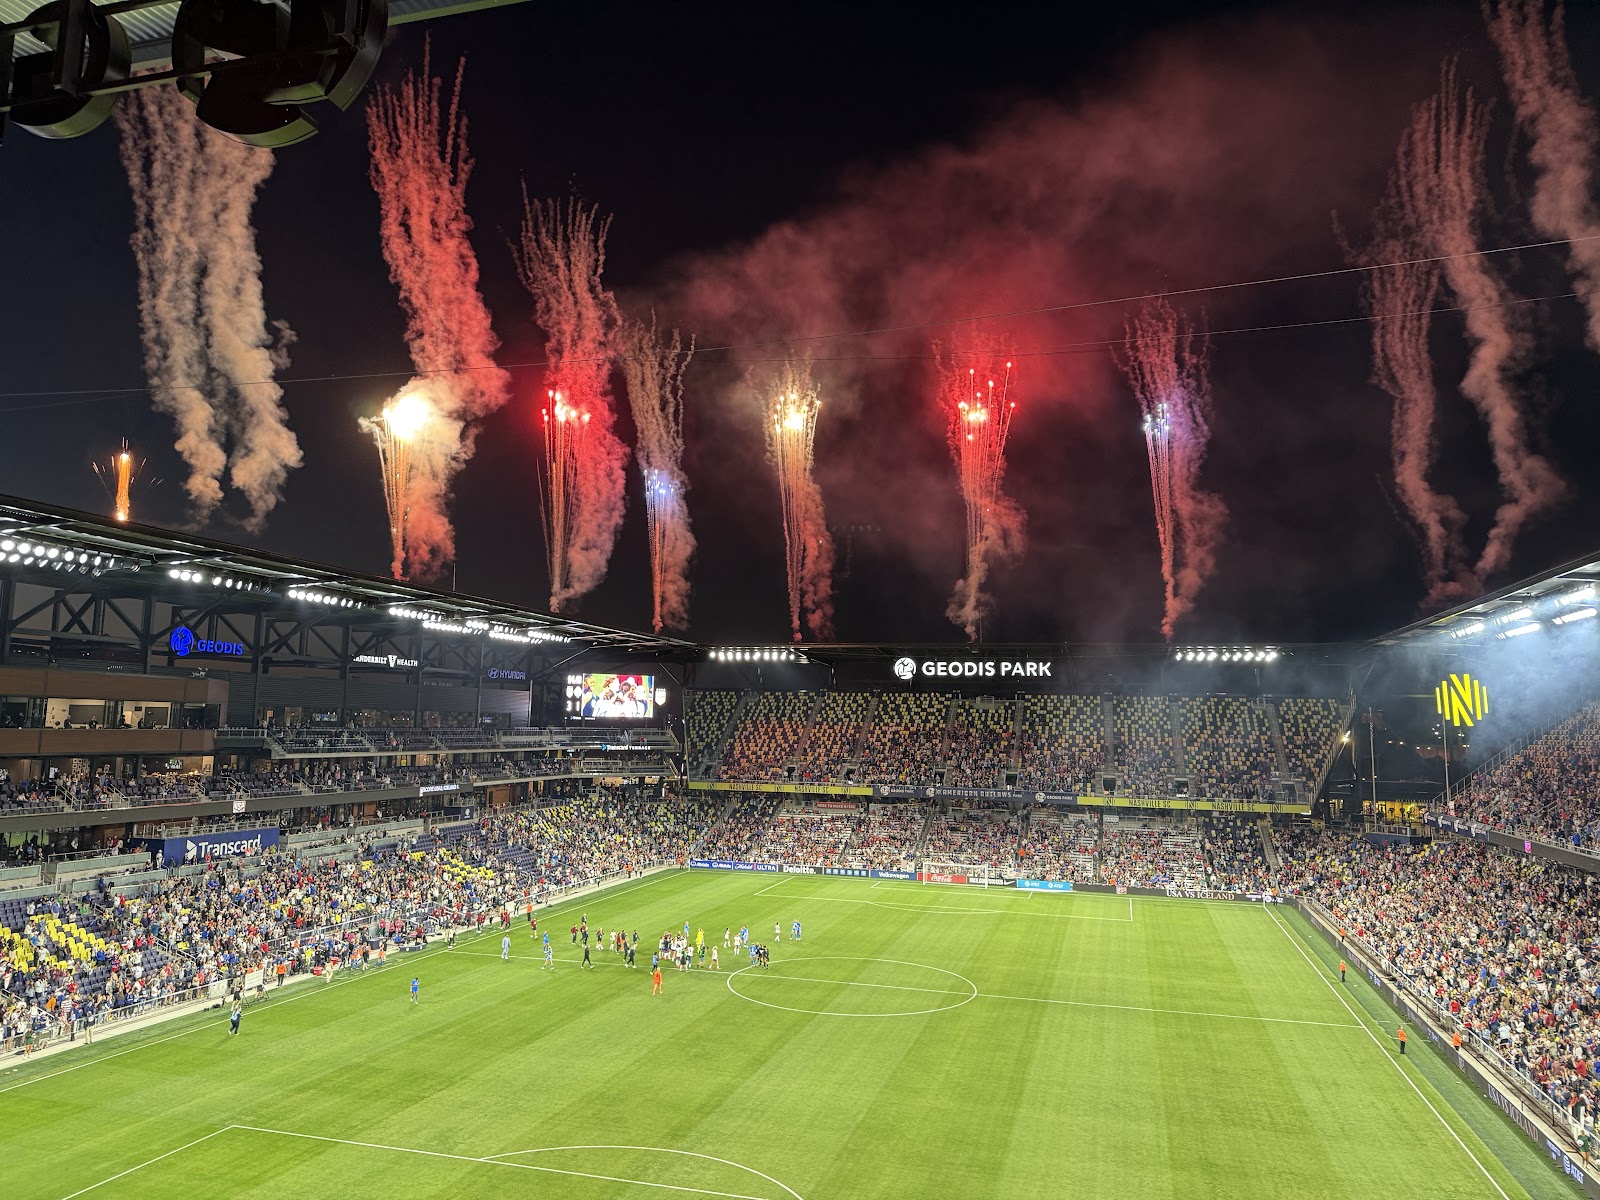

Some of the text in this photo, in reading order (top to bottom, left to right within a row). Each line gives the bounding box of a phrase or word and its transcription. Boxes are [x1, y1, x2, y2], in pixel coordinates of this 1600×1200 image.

[197, 639, 243, 655] GEODIS
[353, 655, 387, 664] ANDERBILT
[397, 658, 418, 667] HEALTH
[922, 661, 1051, 676] GEODIS PARK
[500, 670, 526, 680] HYUNDAI
[794, 785, 821, 793] NASHVILLE
[942, 789, 978, 797] AMERICAN
[1128, 798, 1160, 808] NASHVILLE
[1162, 800, 1171, 808] SC
[1212, 802, 1245, 811] NASHVILLE
[1247, 803, 1255, 811] SC
[199, 834, 261, 858] Transcard
[783, 865, 816, 874] Deloitte.
[879, 871, 910, 880] Volkswagen
[1166, 889, 1235, 901] USA VS ICELAND
[1509, 1104, 1539, 1142] ICELAND
[1570, 1163, 1585, 1185] AT&T
